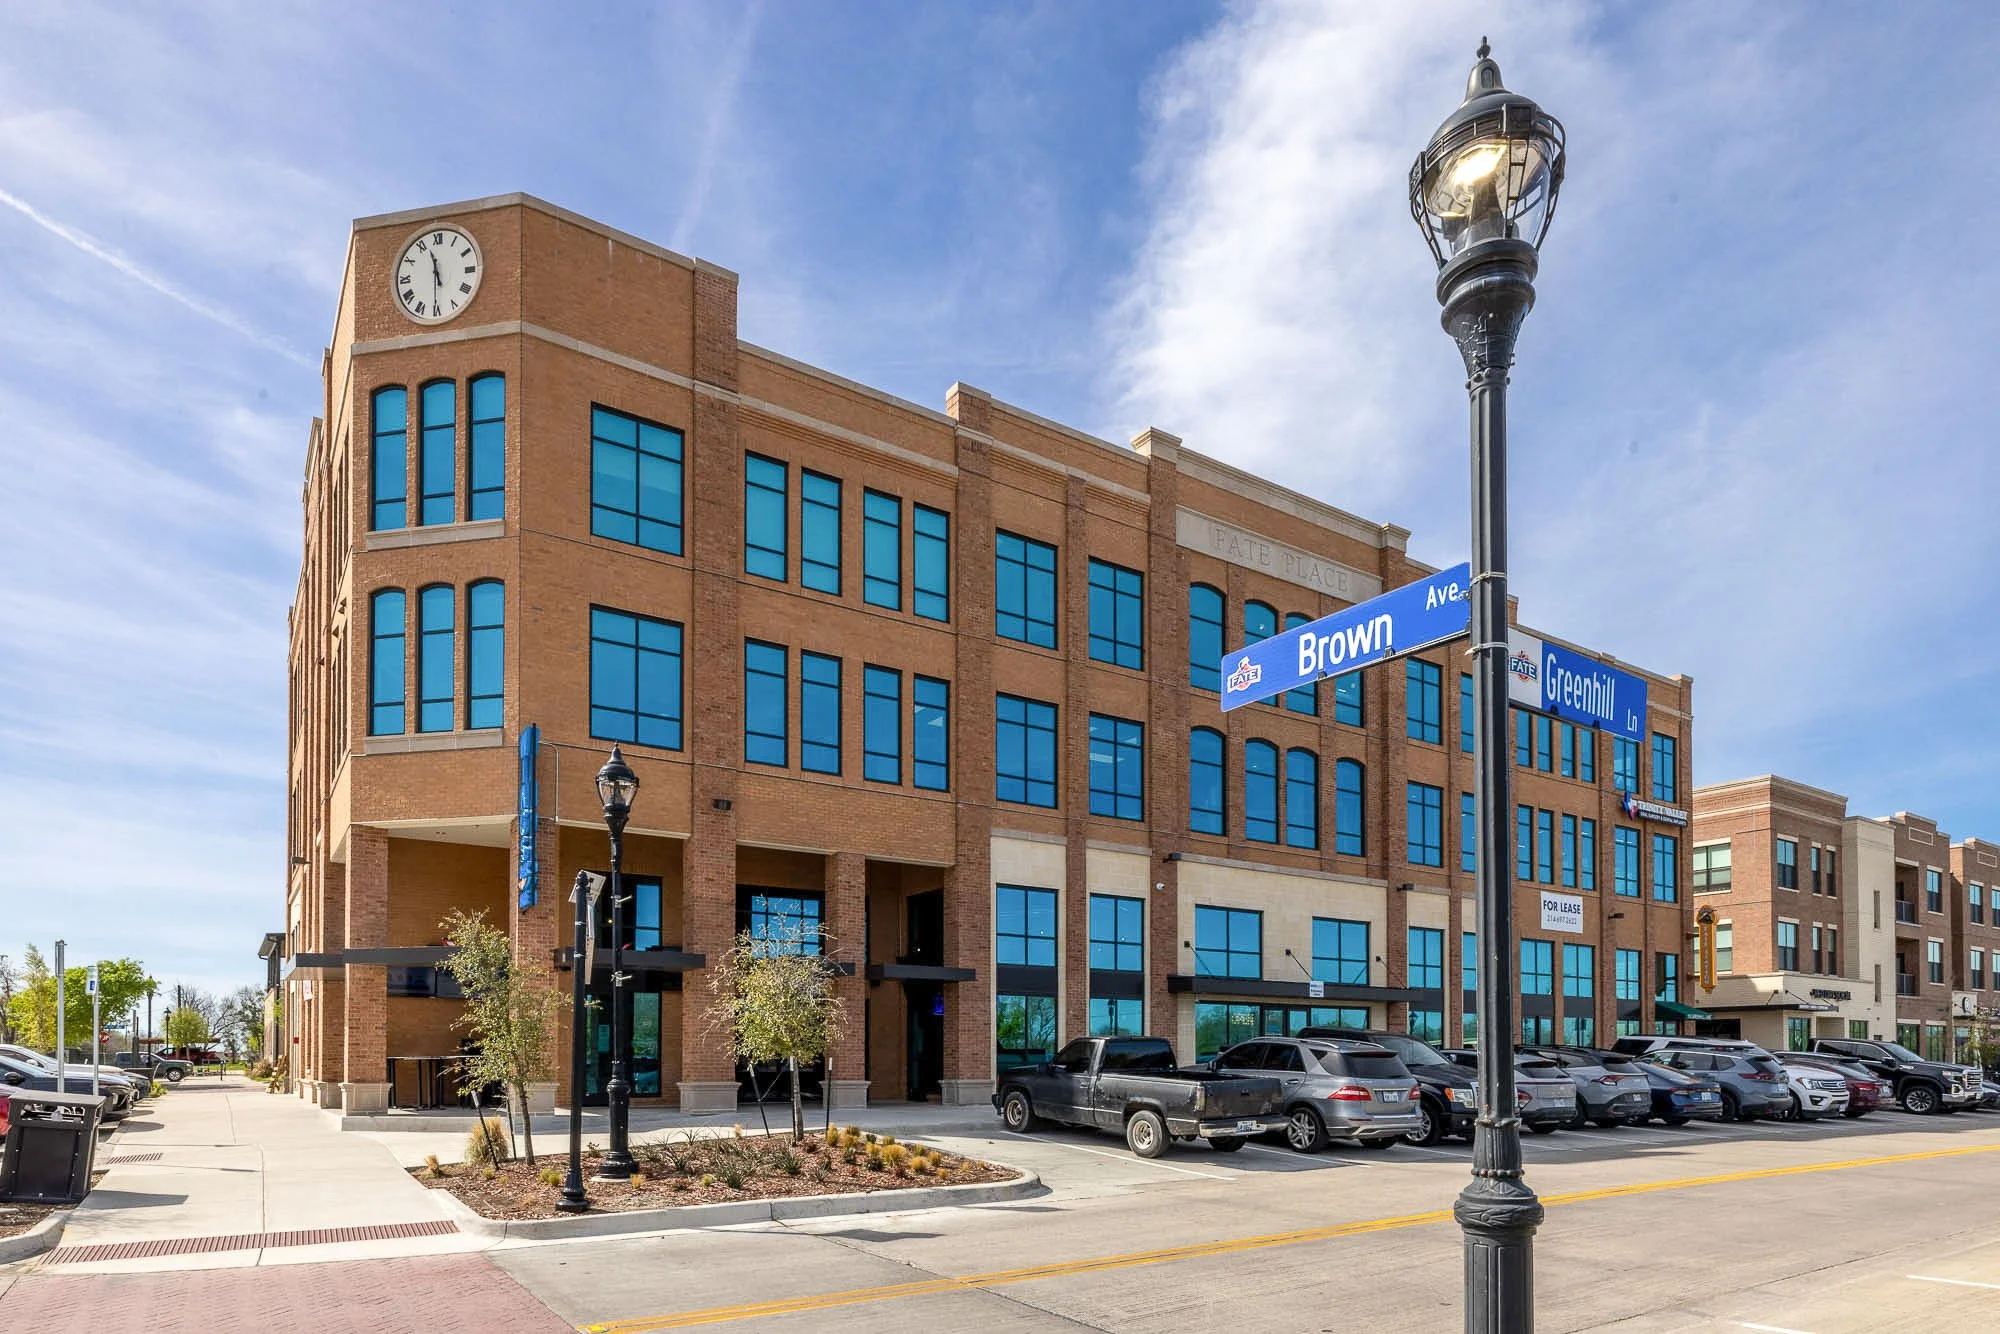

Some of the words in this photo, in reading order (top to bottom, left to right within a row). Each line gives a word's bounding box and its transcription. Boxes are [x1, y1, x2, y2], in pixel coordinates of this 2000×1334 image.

[404, 256, 416, 266] X
[450, 299, 459, 310] V
[1214, 528, 1272, 567] FATE
[1280, 551, 1349, 593] PLACE
[1298, 613, 1393, 677] Brown
[1510, 658, 1536, 678] FATE
[1230, 670, 1257, 687] FATE
[1546, 653, 1615, 721] Greenhill
[1627, 708, 1638, 733] Ln
[1543, 900, 1558, 912] FOR
[1560, 902, 1581, 915] LEASE
